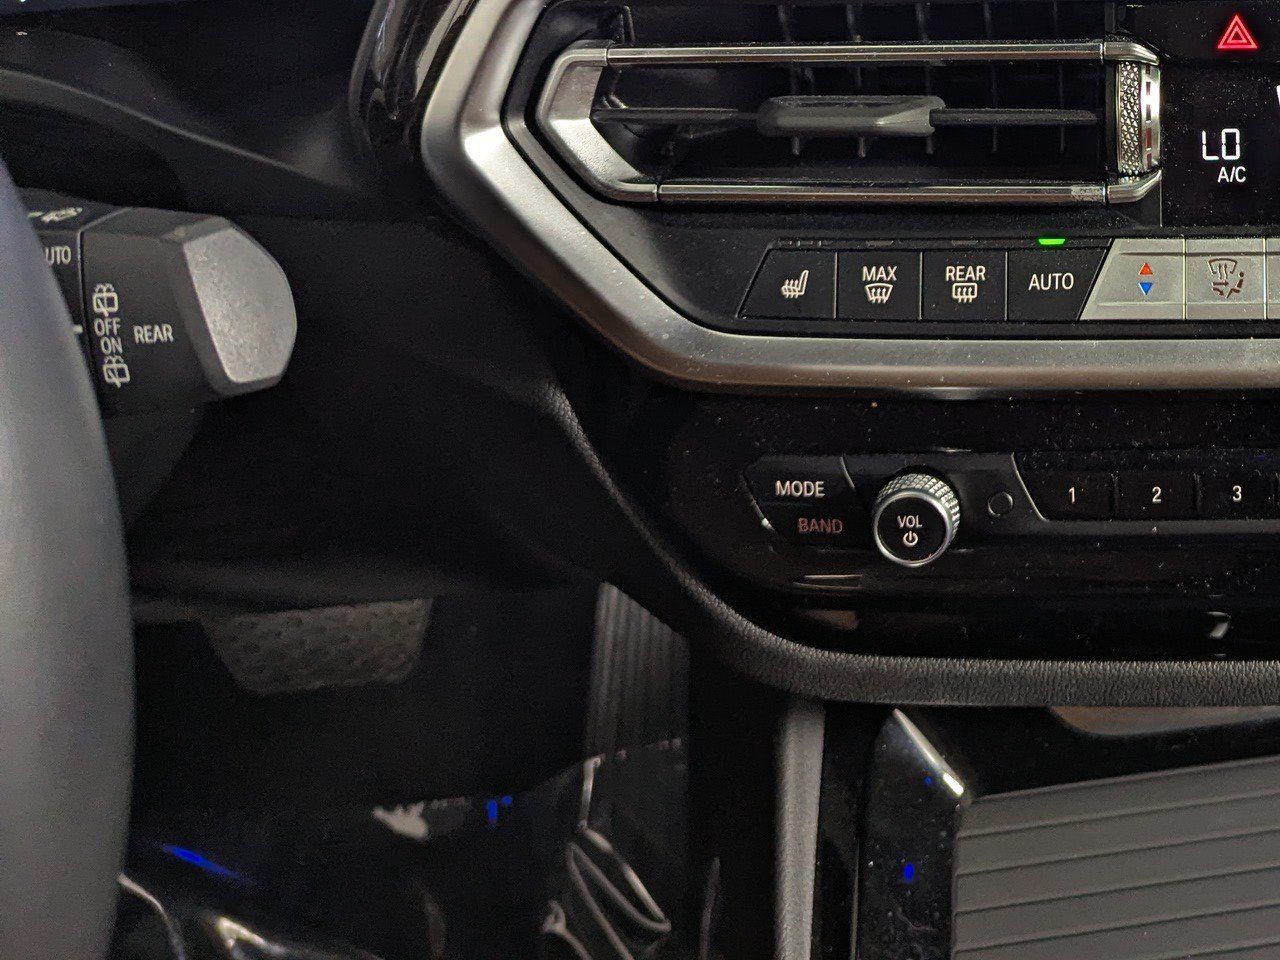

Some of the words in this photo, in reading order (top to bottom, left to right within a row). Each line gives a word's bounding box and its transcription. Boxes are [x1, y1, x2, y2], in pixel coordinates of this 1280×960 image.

[1202, 128, 1241, 161] LO
[1217, 166, 1247, 183] A/C
[45, 245, 72, 265] UTO
[862, 266, 897, 282] MAX
[945, 266, 986, 282] REAR
[1029, 273, 1074, 290] AUTO
[94, 318, 121, 336] OFF
[133, 324, 174, 344] REAR
[100, 337, 122, 355] ON
[775, 480, 825, 498] MODE
[1068, 487, 1076, 504] 1
[1152, 486, 1162, 503] 2
[1232, 485, 1242, 502] 3
[799, 517, 843, 535] BAND
[897, 515, 922, 529] VOL
